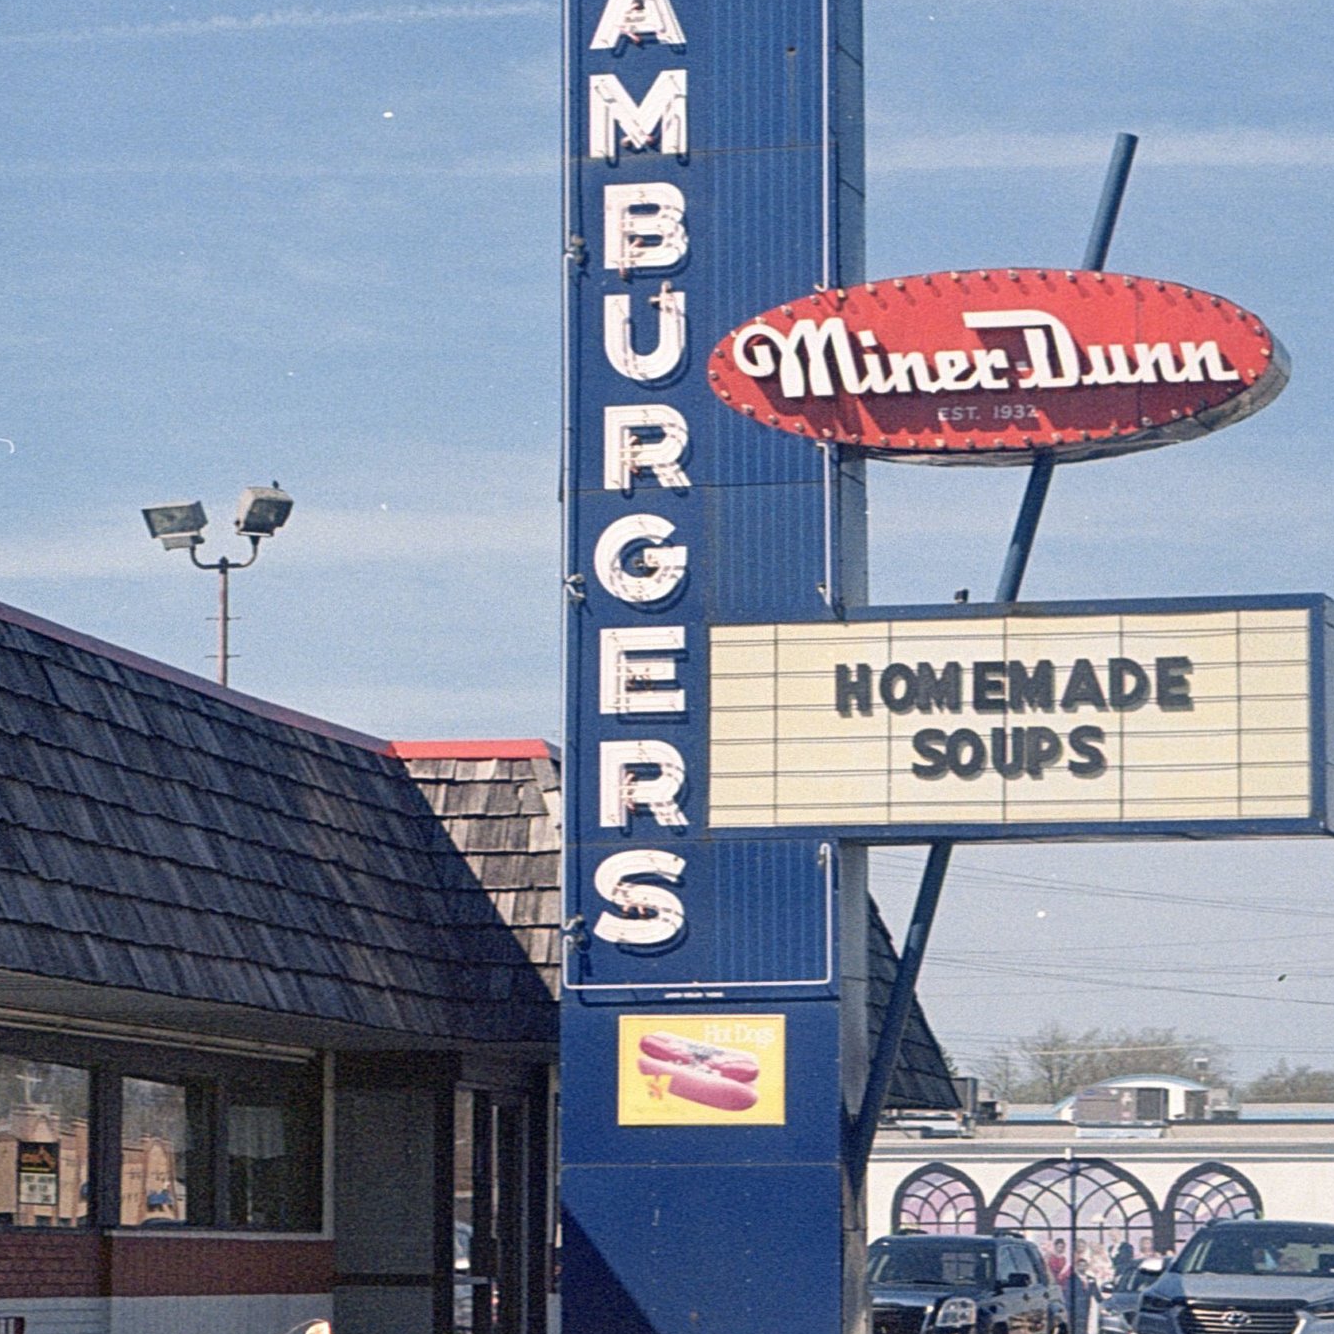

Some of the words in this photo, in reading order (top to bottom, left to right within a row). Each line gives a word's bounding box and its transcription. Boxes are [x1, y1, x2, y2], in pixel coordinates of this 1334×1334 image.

[937, 406, 980, 422] EST.
[993, 405, 1038, 420] 1932
[835, 656, 1194, 717] HOMEMADE
[911, 725, 1107, 780] SOUPS
